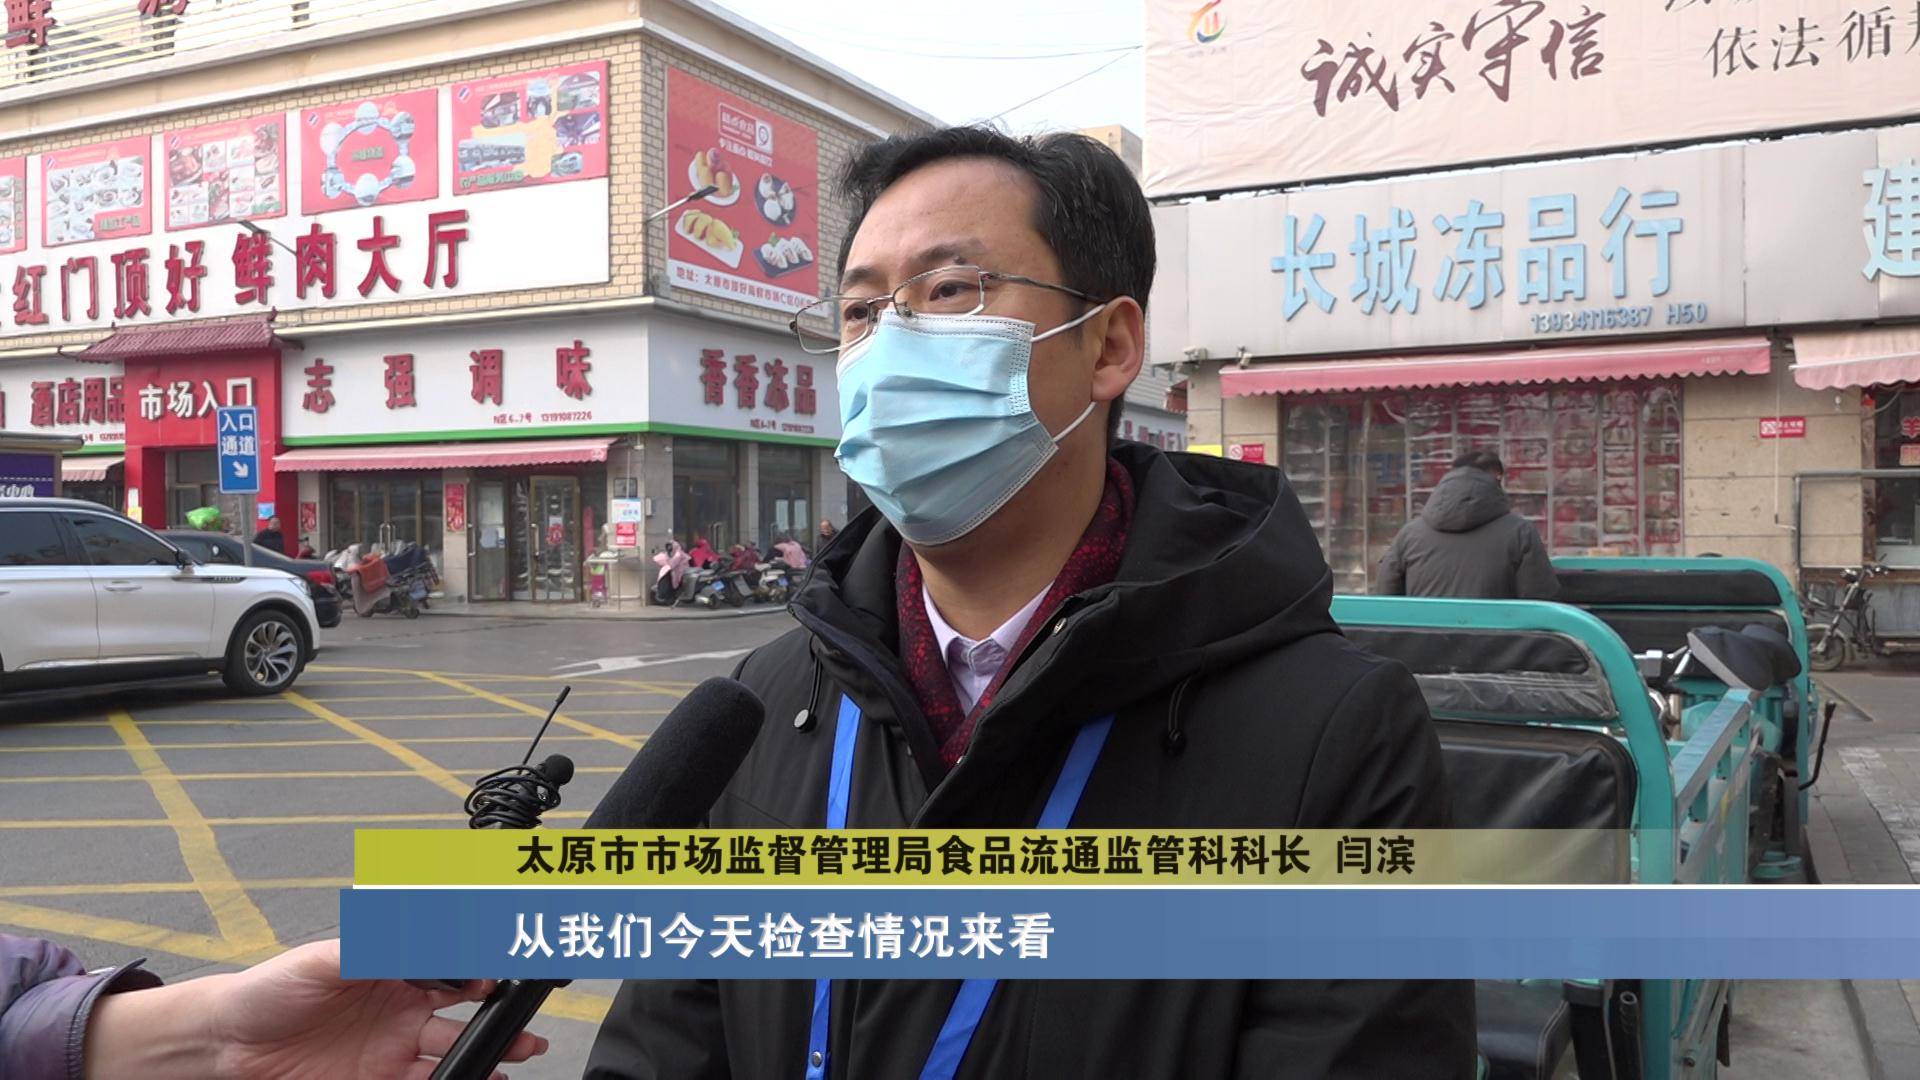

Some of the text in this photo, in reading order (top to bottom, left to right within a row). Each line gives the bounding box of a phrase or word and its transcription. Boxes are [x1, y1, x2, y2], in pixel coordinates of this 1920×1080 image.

[1301, 0, 1606, 117] 诚实守信
[12, 209, 470, 326] 红门顶好鲜肉大厅
[1270, 186, 1683, 321] 长城冻品行
[1530, 302, 1708, 334] 13934116387 H50
[30, 376, 126, 428] 酒店用品
[138, 376, 254, 421] 市场入口
[303, 339, 593, 414] 志强调味
[221, 413, 255, 433] 入口
[221, 436, 256, 457] 通道
